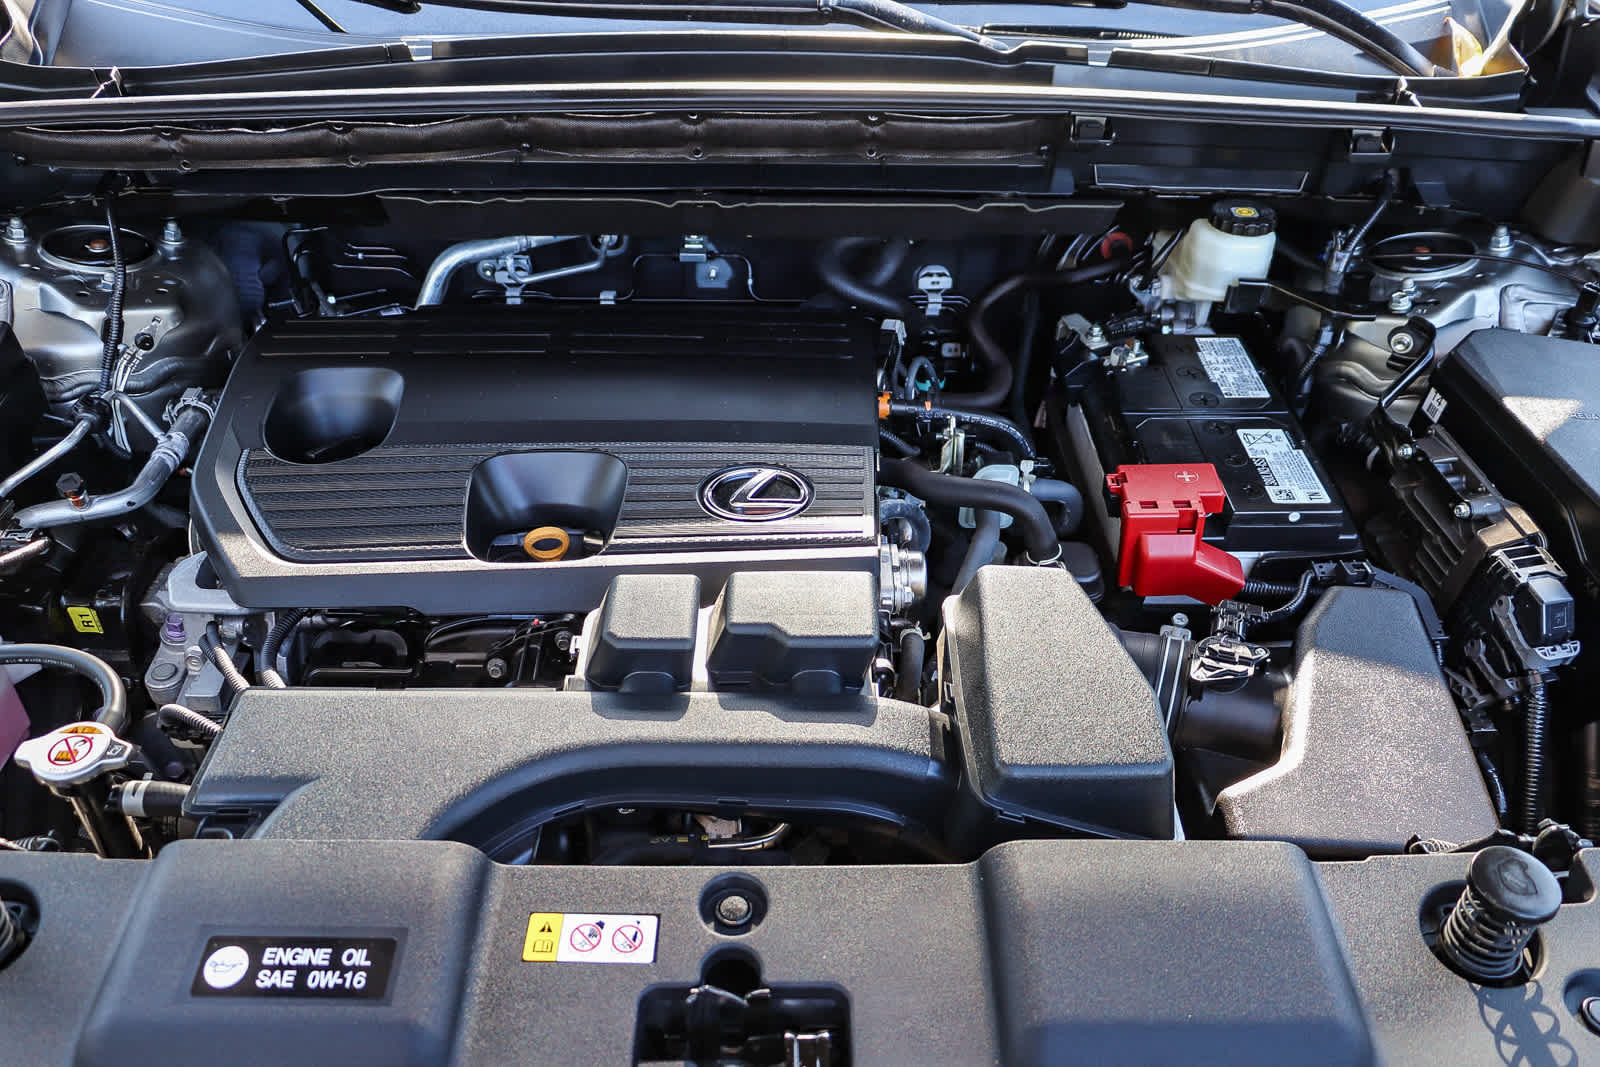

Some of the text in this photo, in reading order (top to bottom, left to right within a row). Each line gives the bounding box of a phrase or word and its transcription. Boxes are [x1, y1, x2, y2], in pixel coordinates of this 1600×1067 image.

[78, 614, 95, 628] R1
[261, 947, 371, 967] ENGINE OIL
[255, 969, 367, 990] SAE 0W-16
